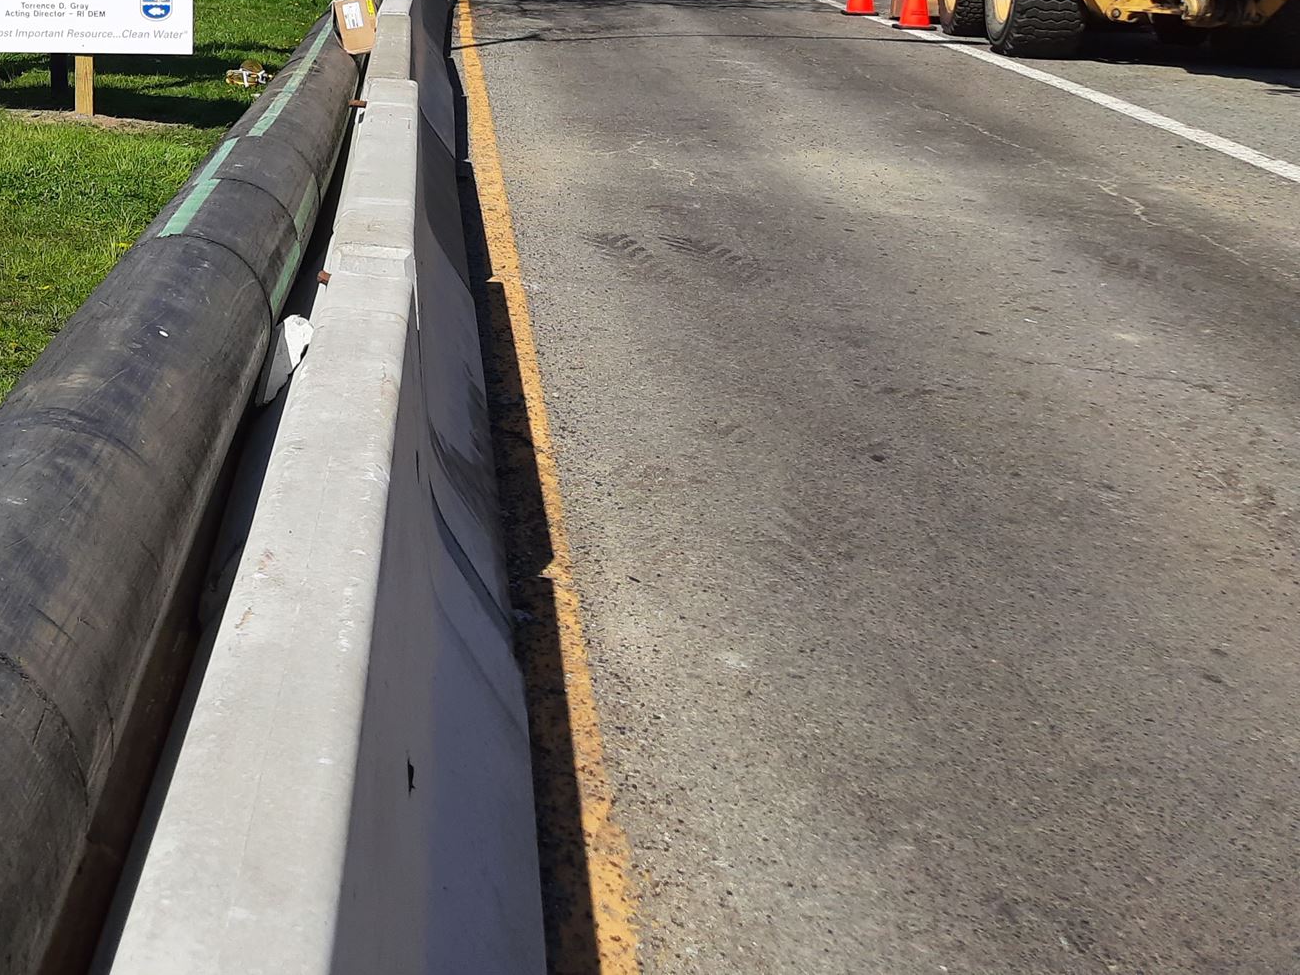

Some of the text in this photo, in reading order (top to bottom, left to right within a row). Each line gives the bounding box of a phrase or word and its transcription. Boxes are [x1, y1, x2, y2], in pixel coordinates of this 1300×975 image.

[70, 2, 89, 11] Gray
[5, 10, 30, 18] Acting
[15, 29, 64, 39] Important
